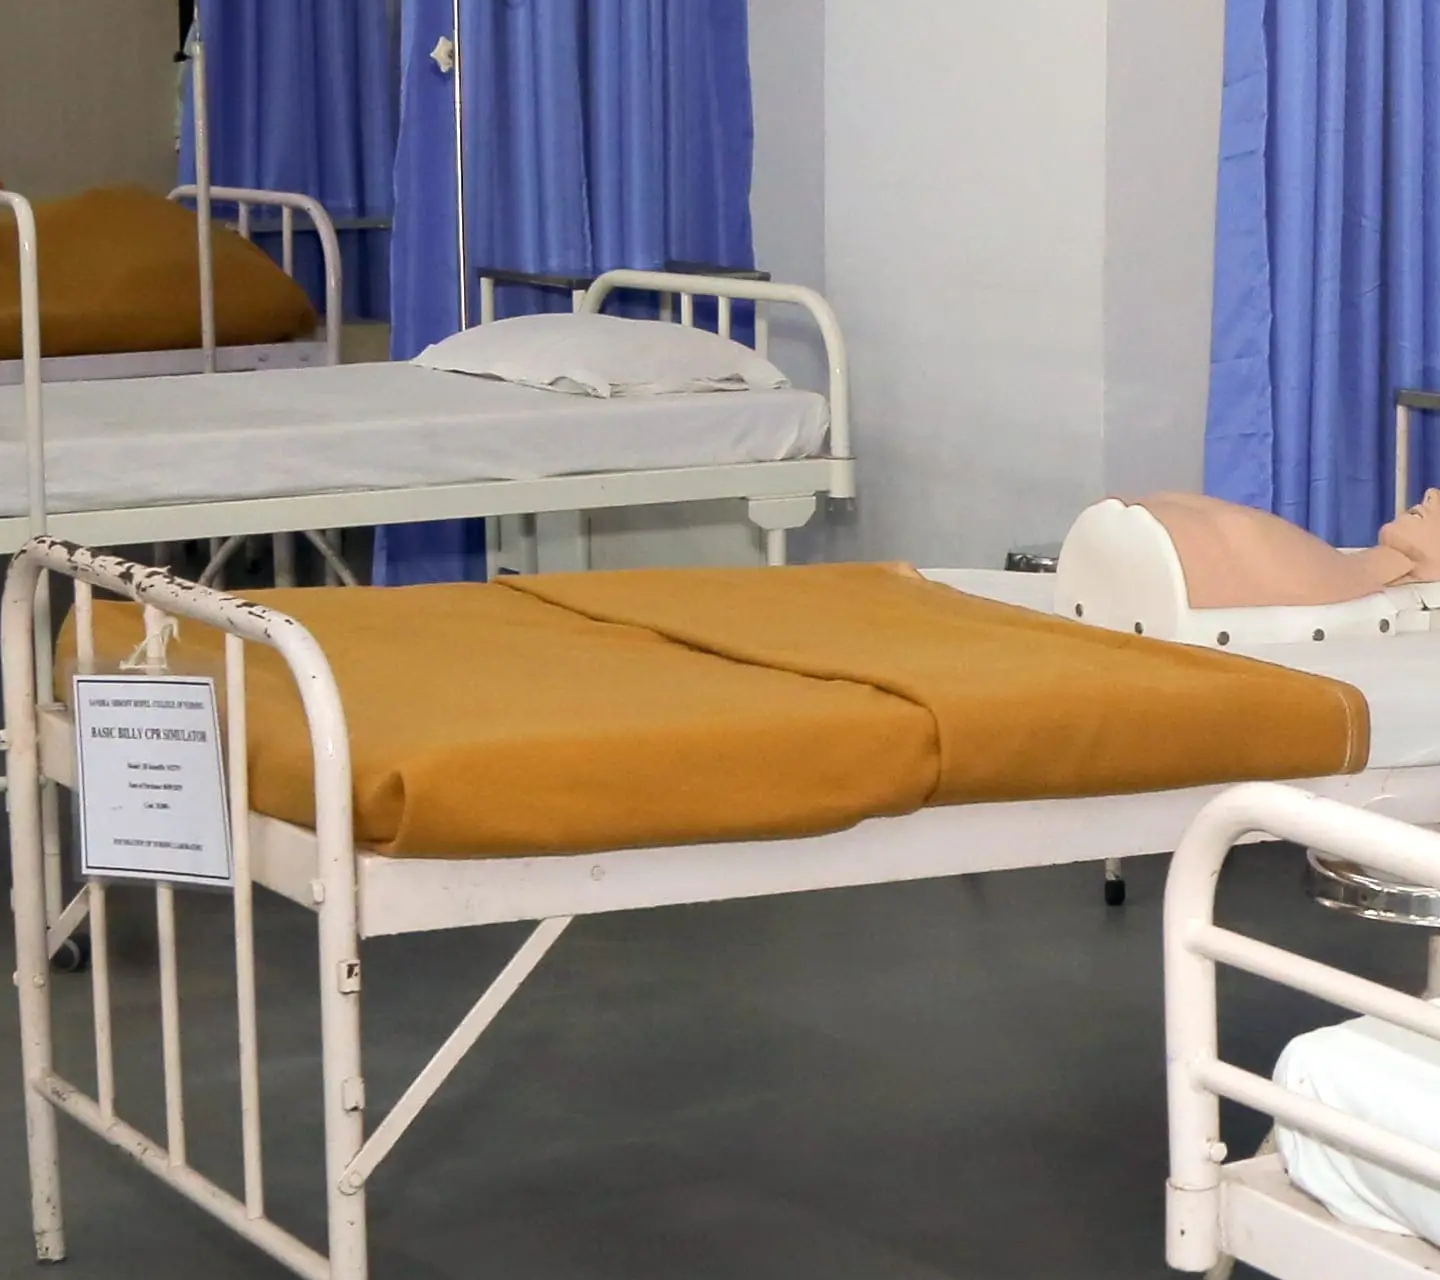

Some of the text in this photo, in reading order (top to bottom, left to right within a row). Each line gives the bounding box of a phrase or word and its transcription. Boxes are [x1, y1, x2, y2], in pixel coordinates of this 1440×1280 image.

[91, 727, 207, 743] BASIC BILLY CPR SIMULATOR
